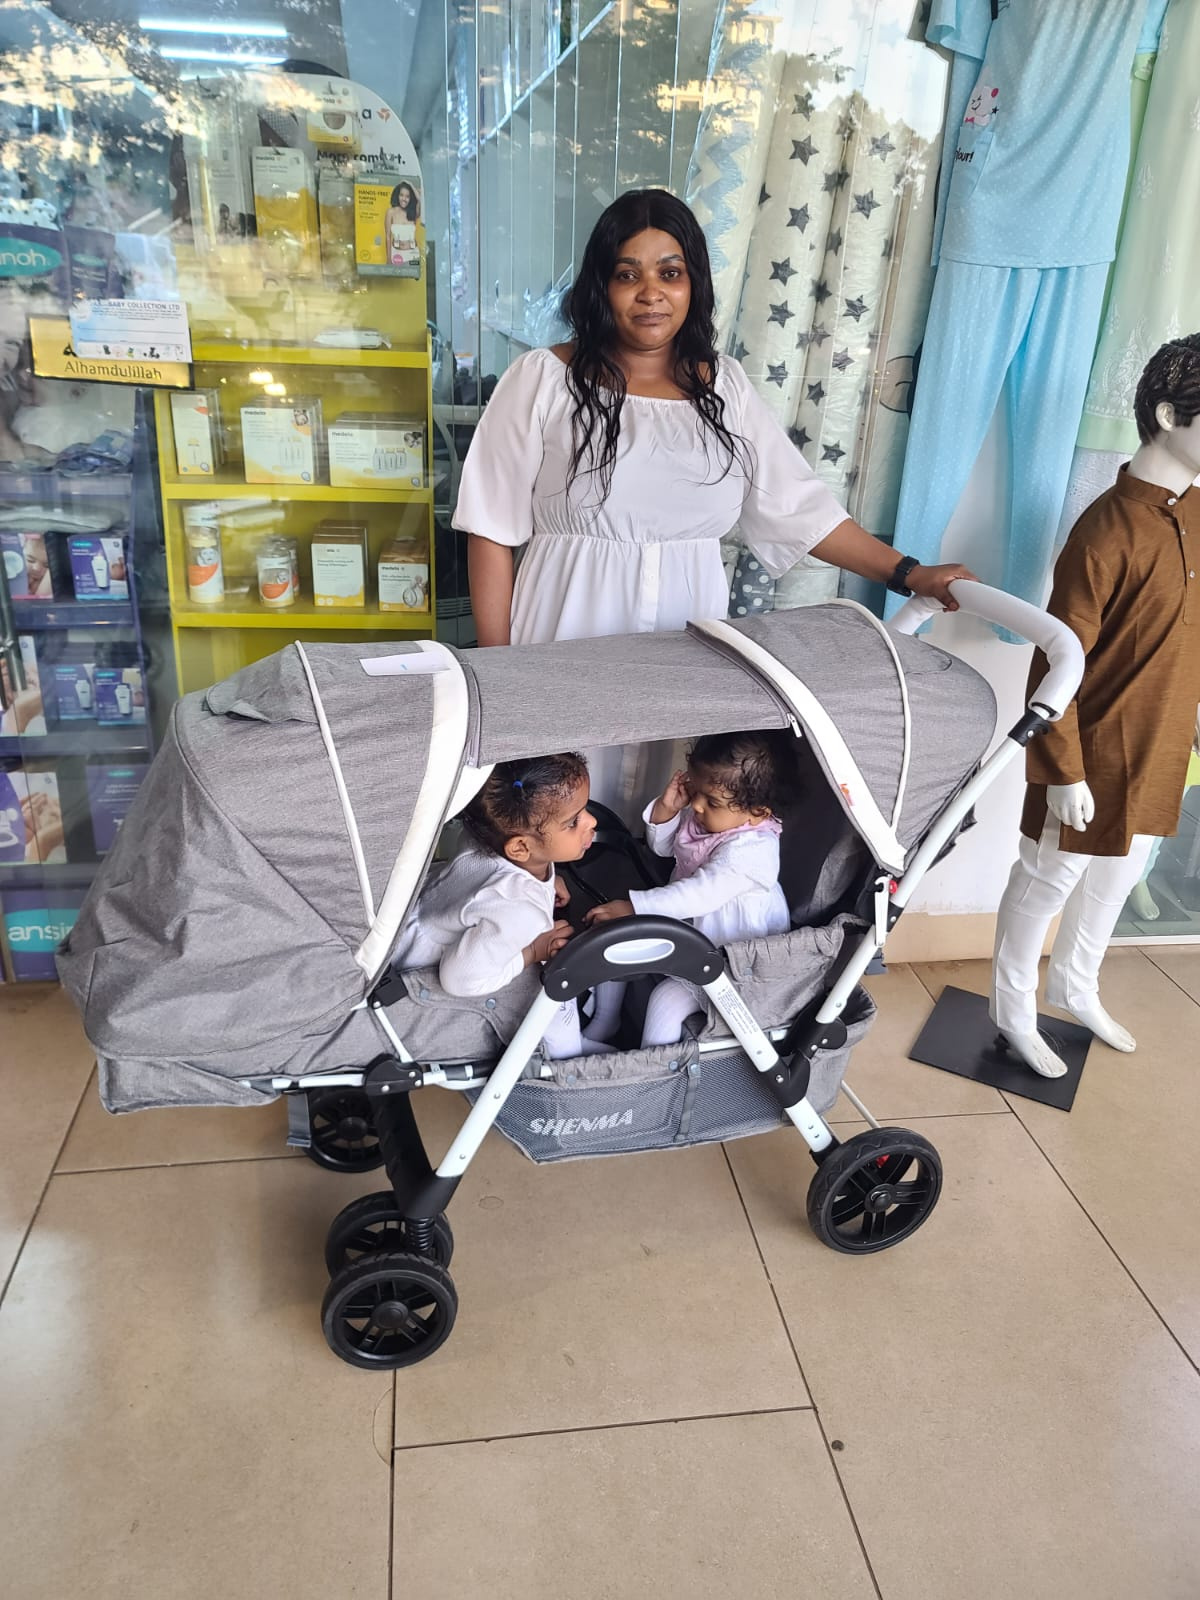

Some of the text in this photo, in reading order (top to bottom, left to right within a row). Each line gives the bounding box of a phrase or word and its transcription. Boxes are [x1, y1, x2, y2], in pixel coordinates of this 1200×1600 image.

[127, 301, 167, 310] COLLECTION
[168, 303, 181, 311] LTD
[64, 360, 162, 380] Alhamdulillah
[527, 1108, 634, 1137] SHENMA
